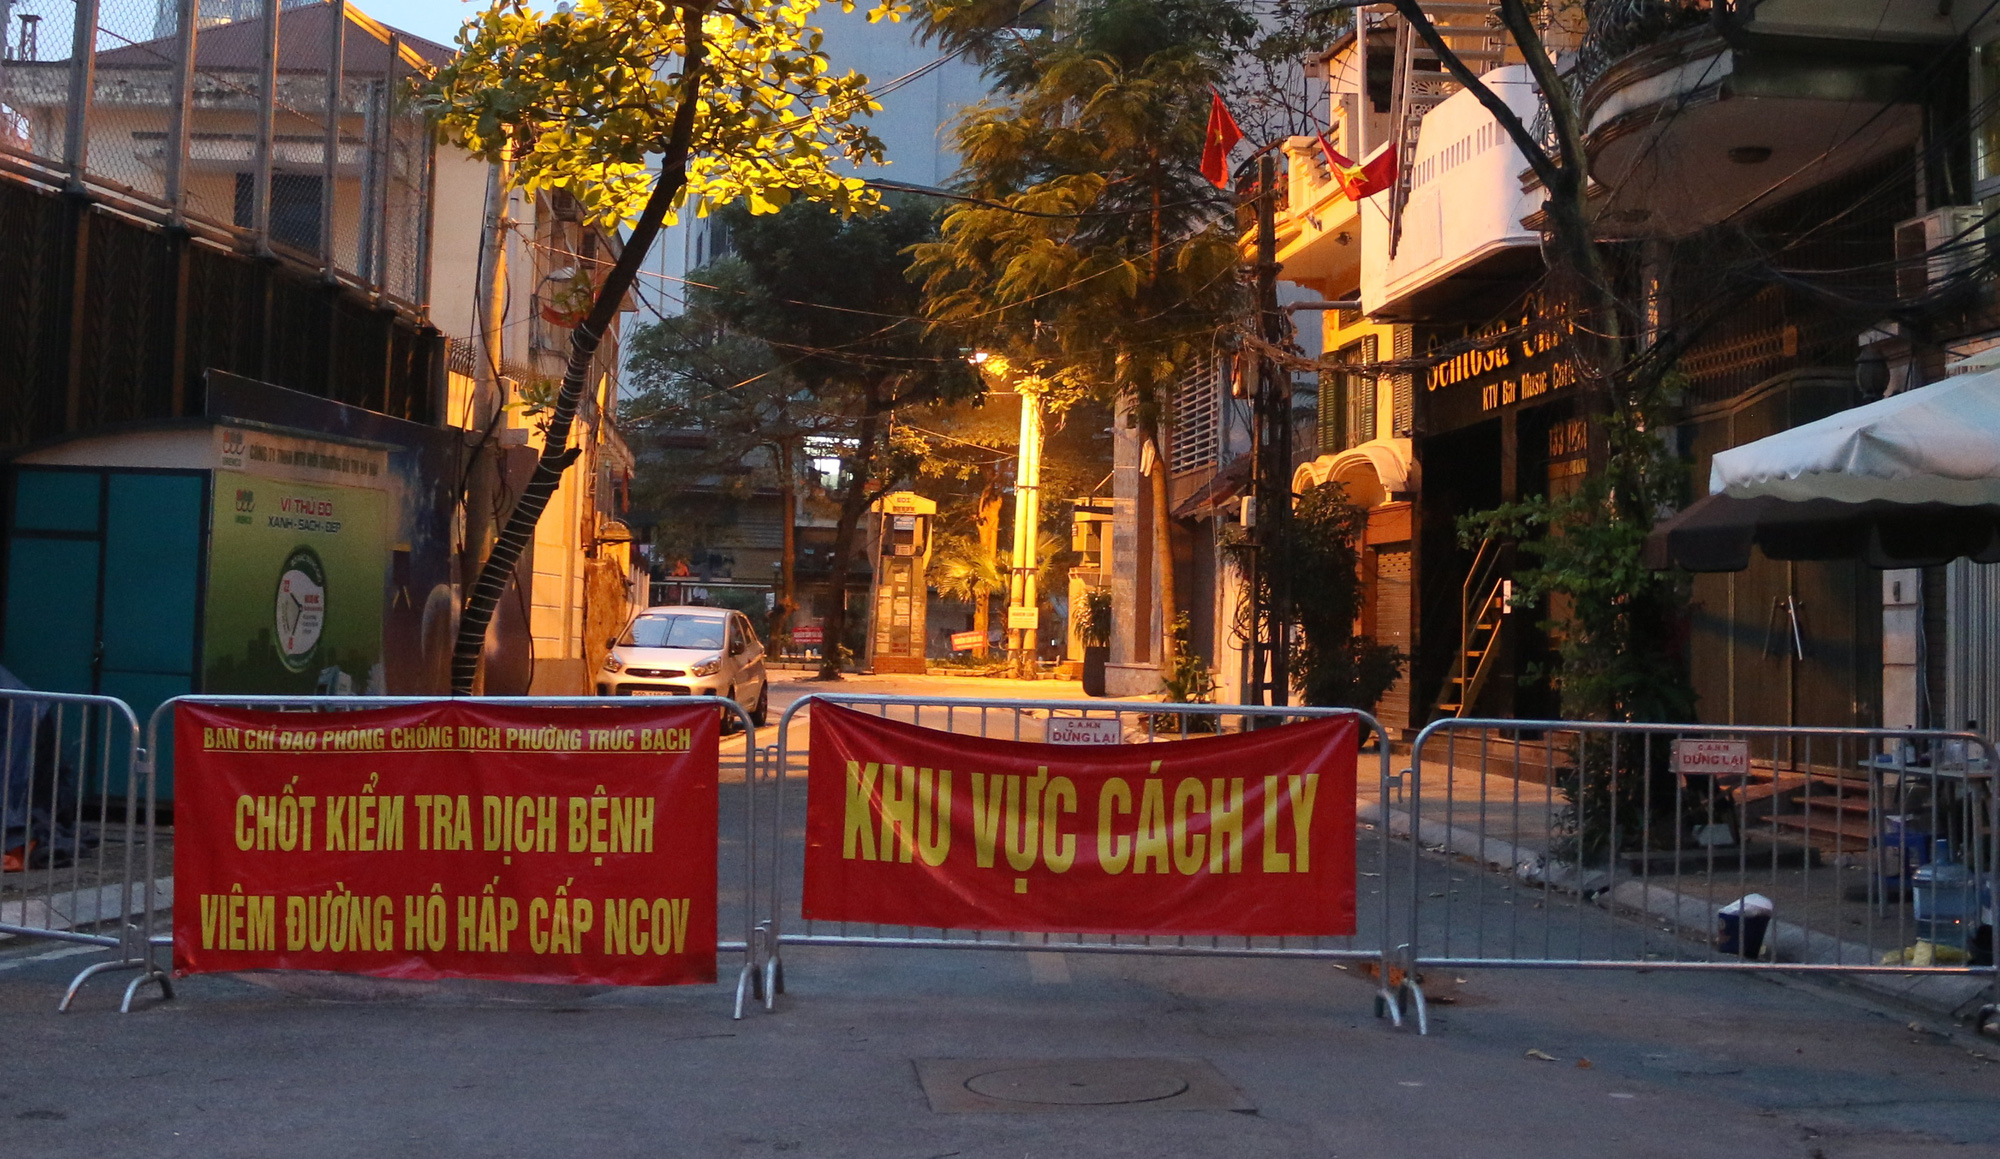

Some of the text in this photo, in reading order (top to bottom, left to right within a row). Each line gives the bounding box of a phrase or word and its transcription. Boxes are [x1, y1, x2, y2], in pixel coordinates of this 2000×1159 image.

[1482, 384, 1498, 411] KTV
[1502, 379, 1516, 406] Bar
[1521, 371, 1548, 399] Music
[268, 515, 293, 529] XANH
[204, 719, 691, 755] BAN CHỈ ĐẠO PHÒNG CHỐNG DỊCH PHƯỜNG TRÚC BẠCH
[1053, 729, 1090, 743] DỪNG
[235, 771, 655, 867] CHỐT KIỂM TRA DỊCH BỆNH
[842, 759, 1320, 894] KHU VỰC CÁCH LY
[200, 875, 691, 956] VIÊM ĐƯỜNG HÔ HẤP CẤP NCOV
